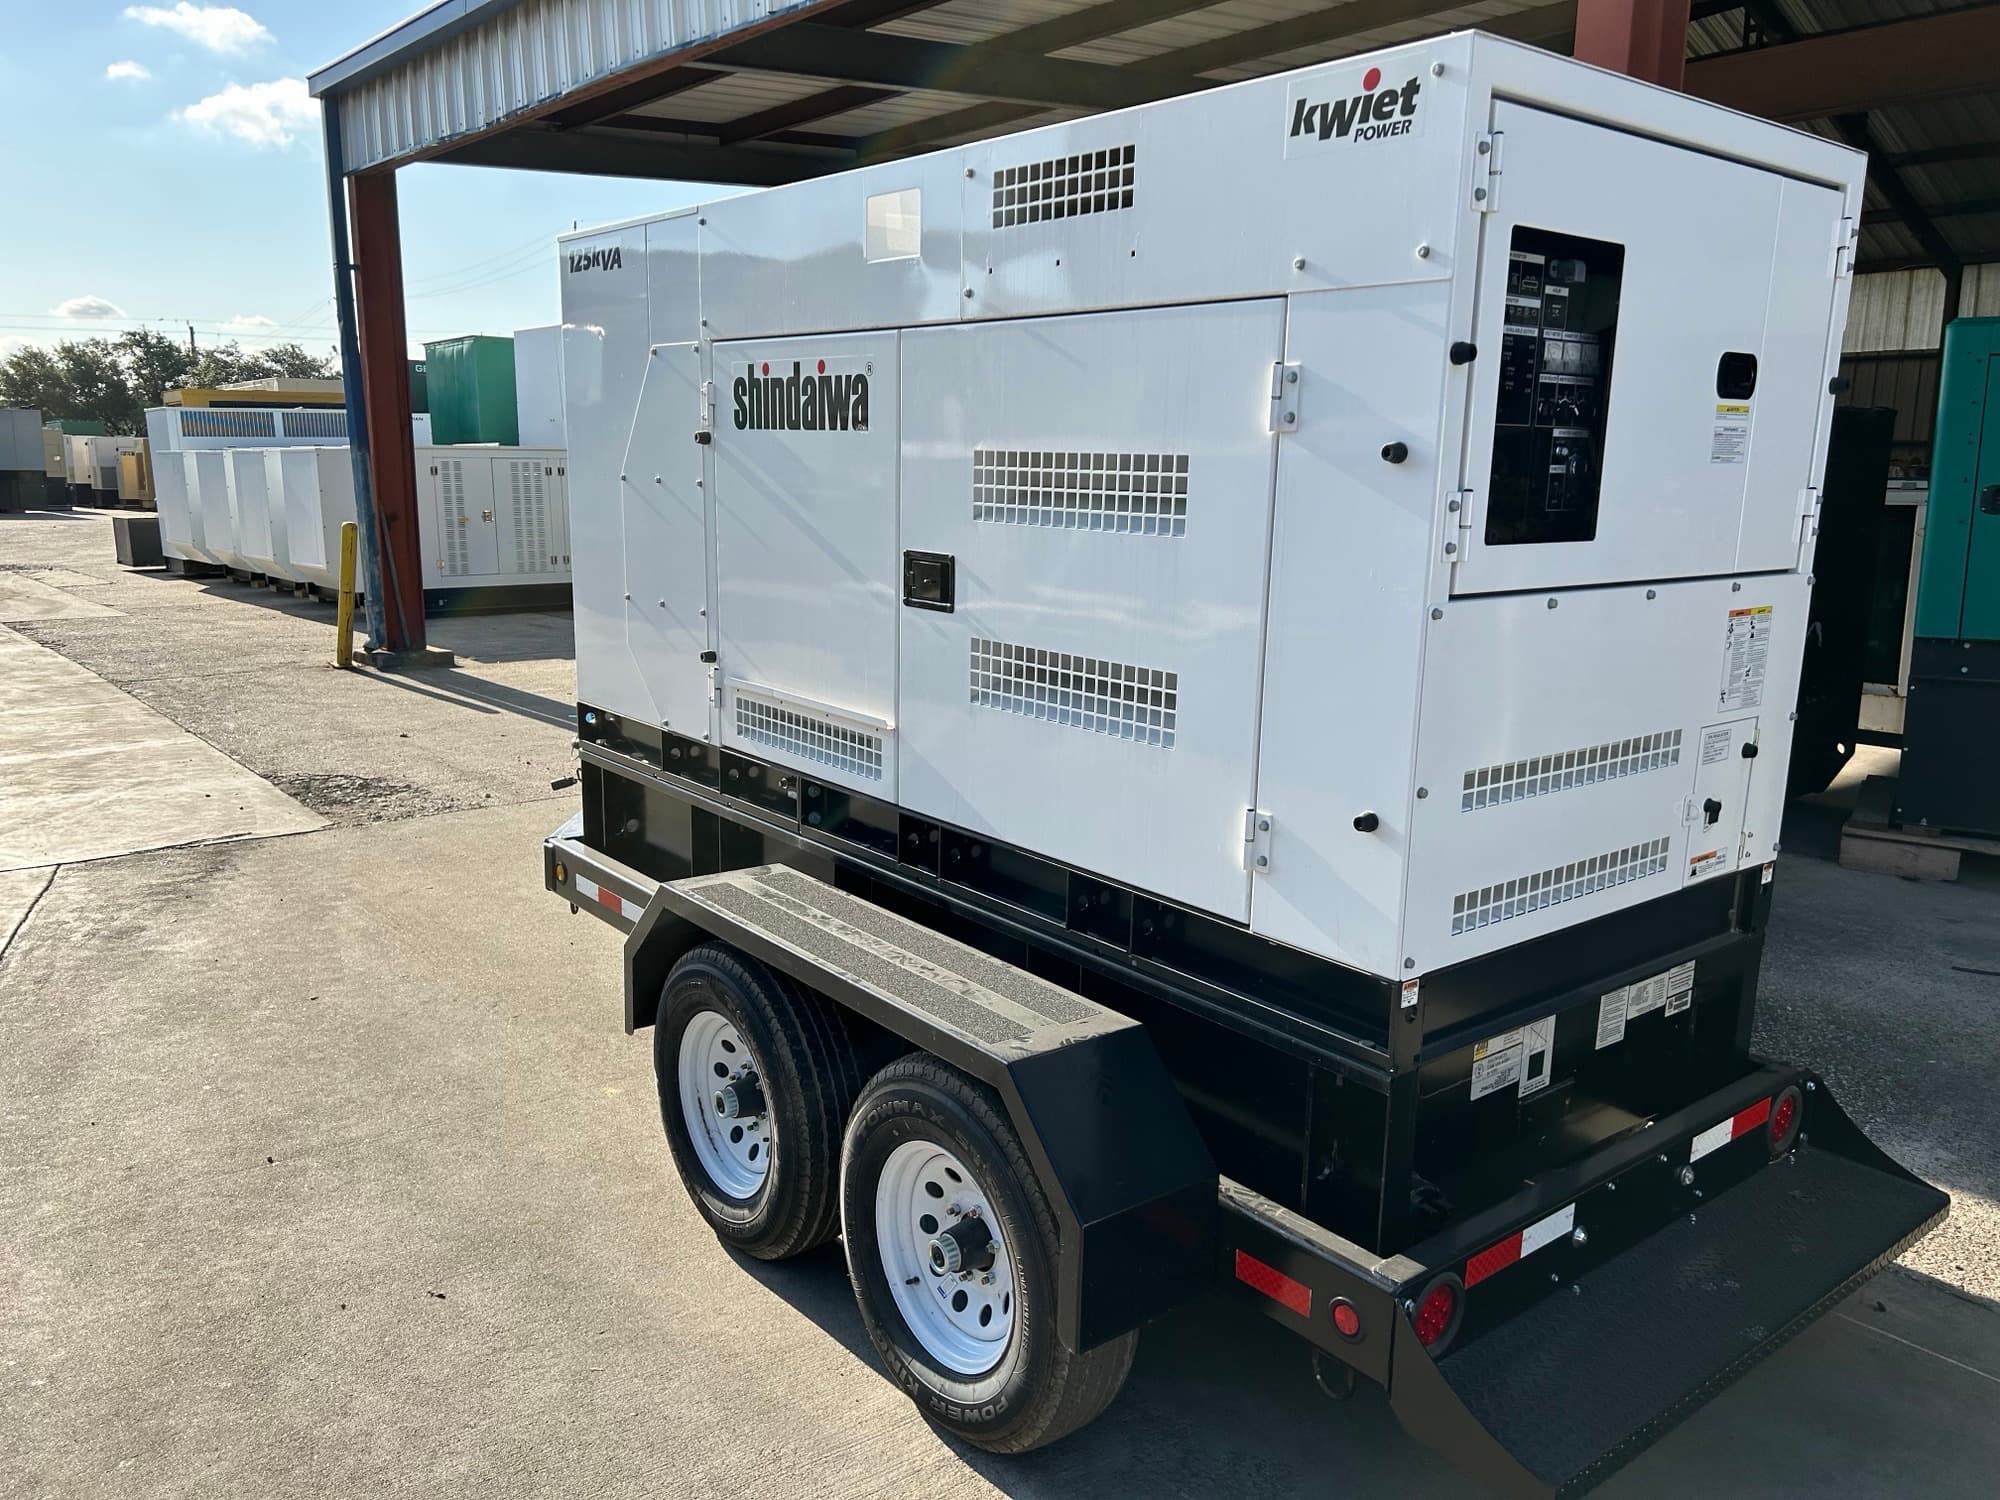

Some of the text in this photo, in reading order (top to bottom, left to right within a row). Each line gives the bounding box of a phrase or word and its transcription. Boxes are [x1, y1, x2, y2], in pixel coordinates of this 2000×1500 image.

[1290, 67, 1420, 141] kwiet
[1354, 119, 1413, 143] POWER
[568, 246, 622, 273] 125kVA
[733, 359, 869, 432] shindaiwa
[929, 1395, 1009, 1424] POWER
